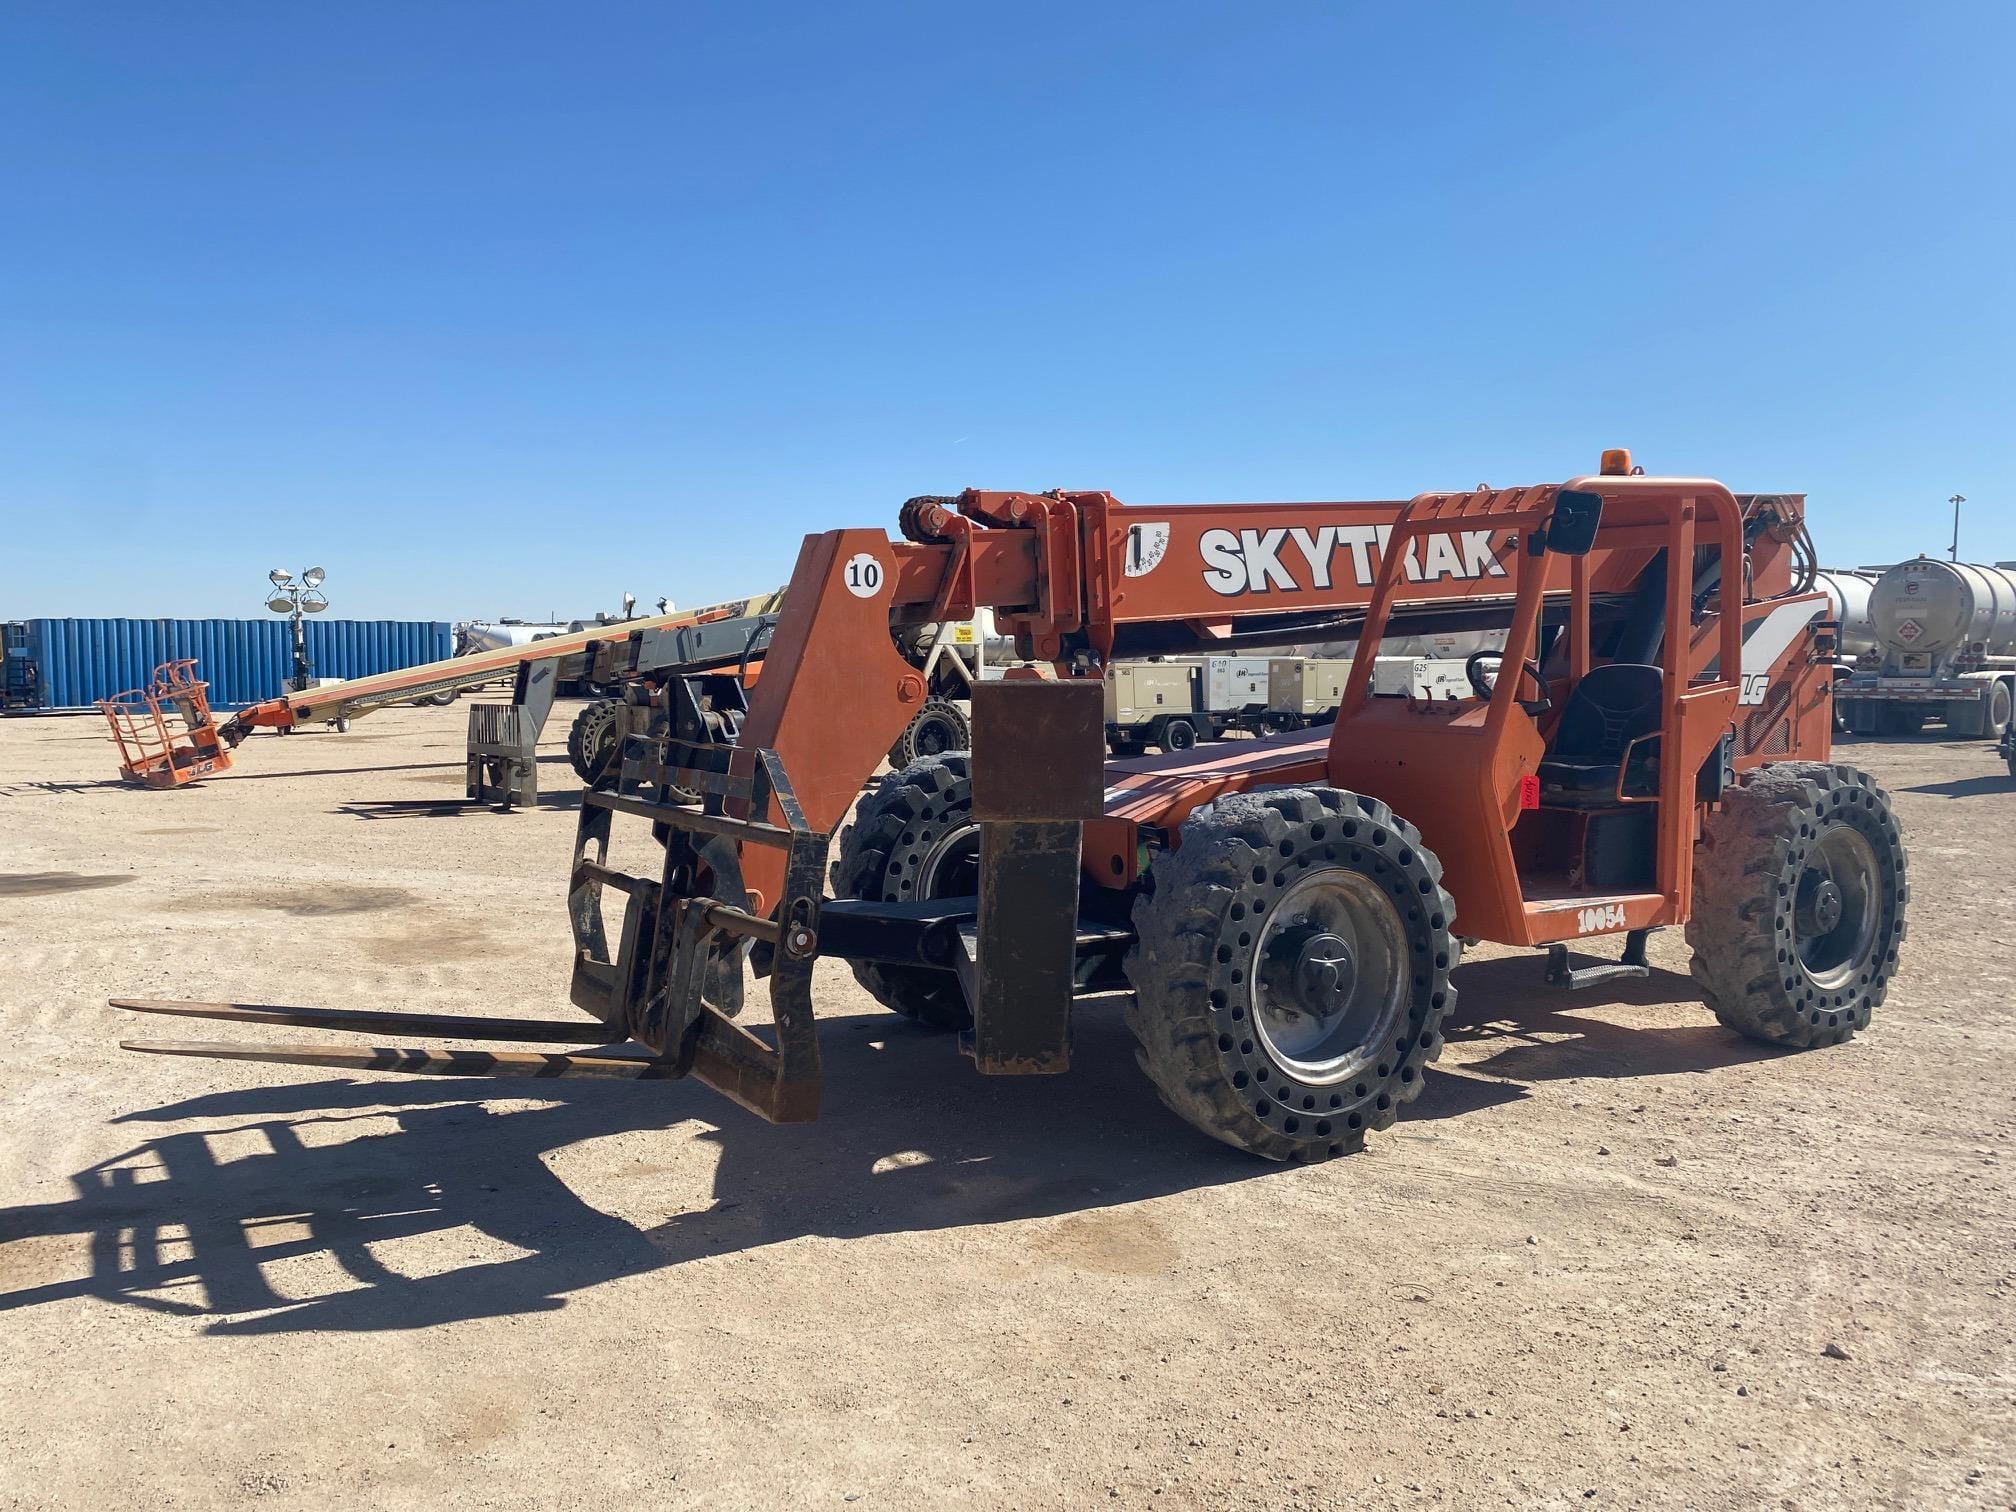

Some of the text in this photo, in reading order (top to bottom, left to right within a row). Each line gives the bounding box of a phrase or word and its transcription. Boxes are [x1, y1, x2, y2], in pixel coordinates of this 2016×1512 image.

[849, 563, 879, 588] 10
[1414, 663, 1427, 672] G25
[1738, 674, 1771, 706] LG
[1577, 903, 1627, 934] 10054
